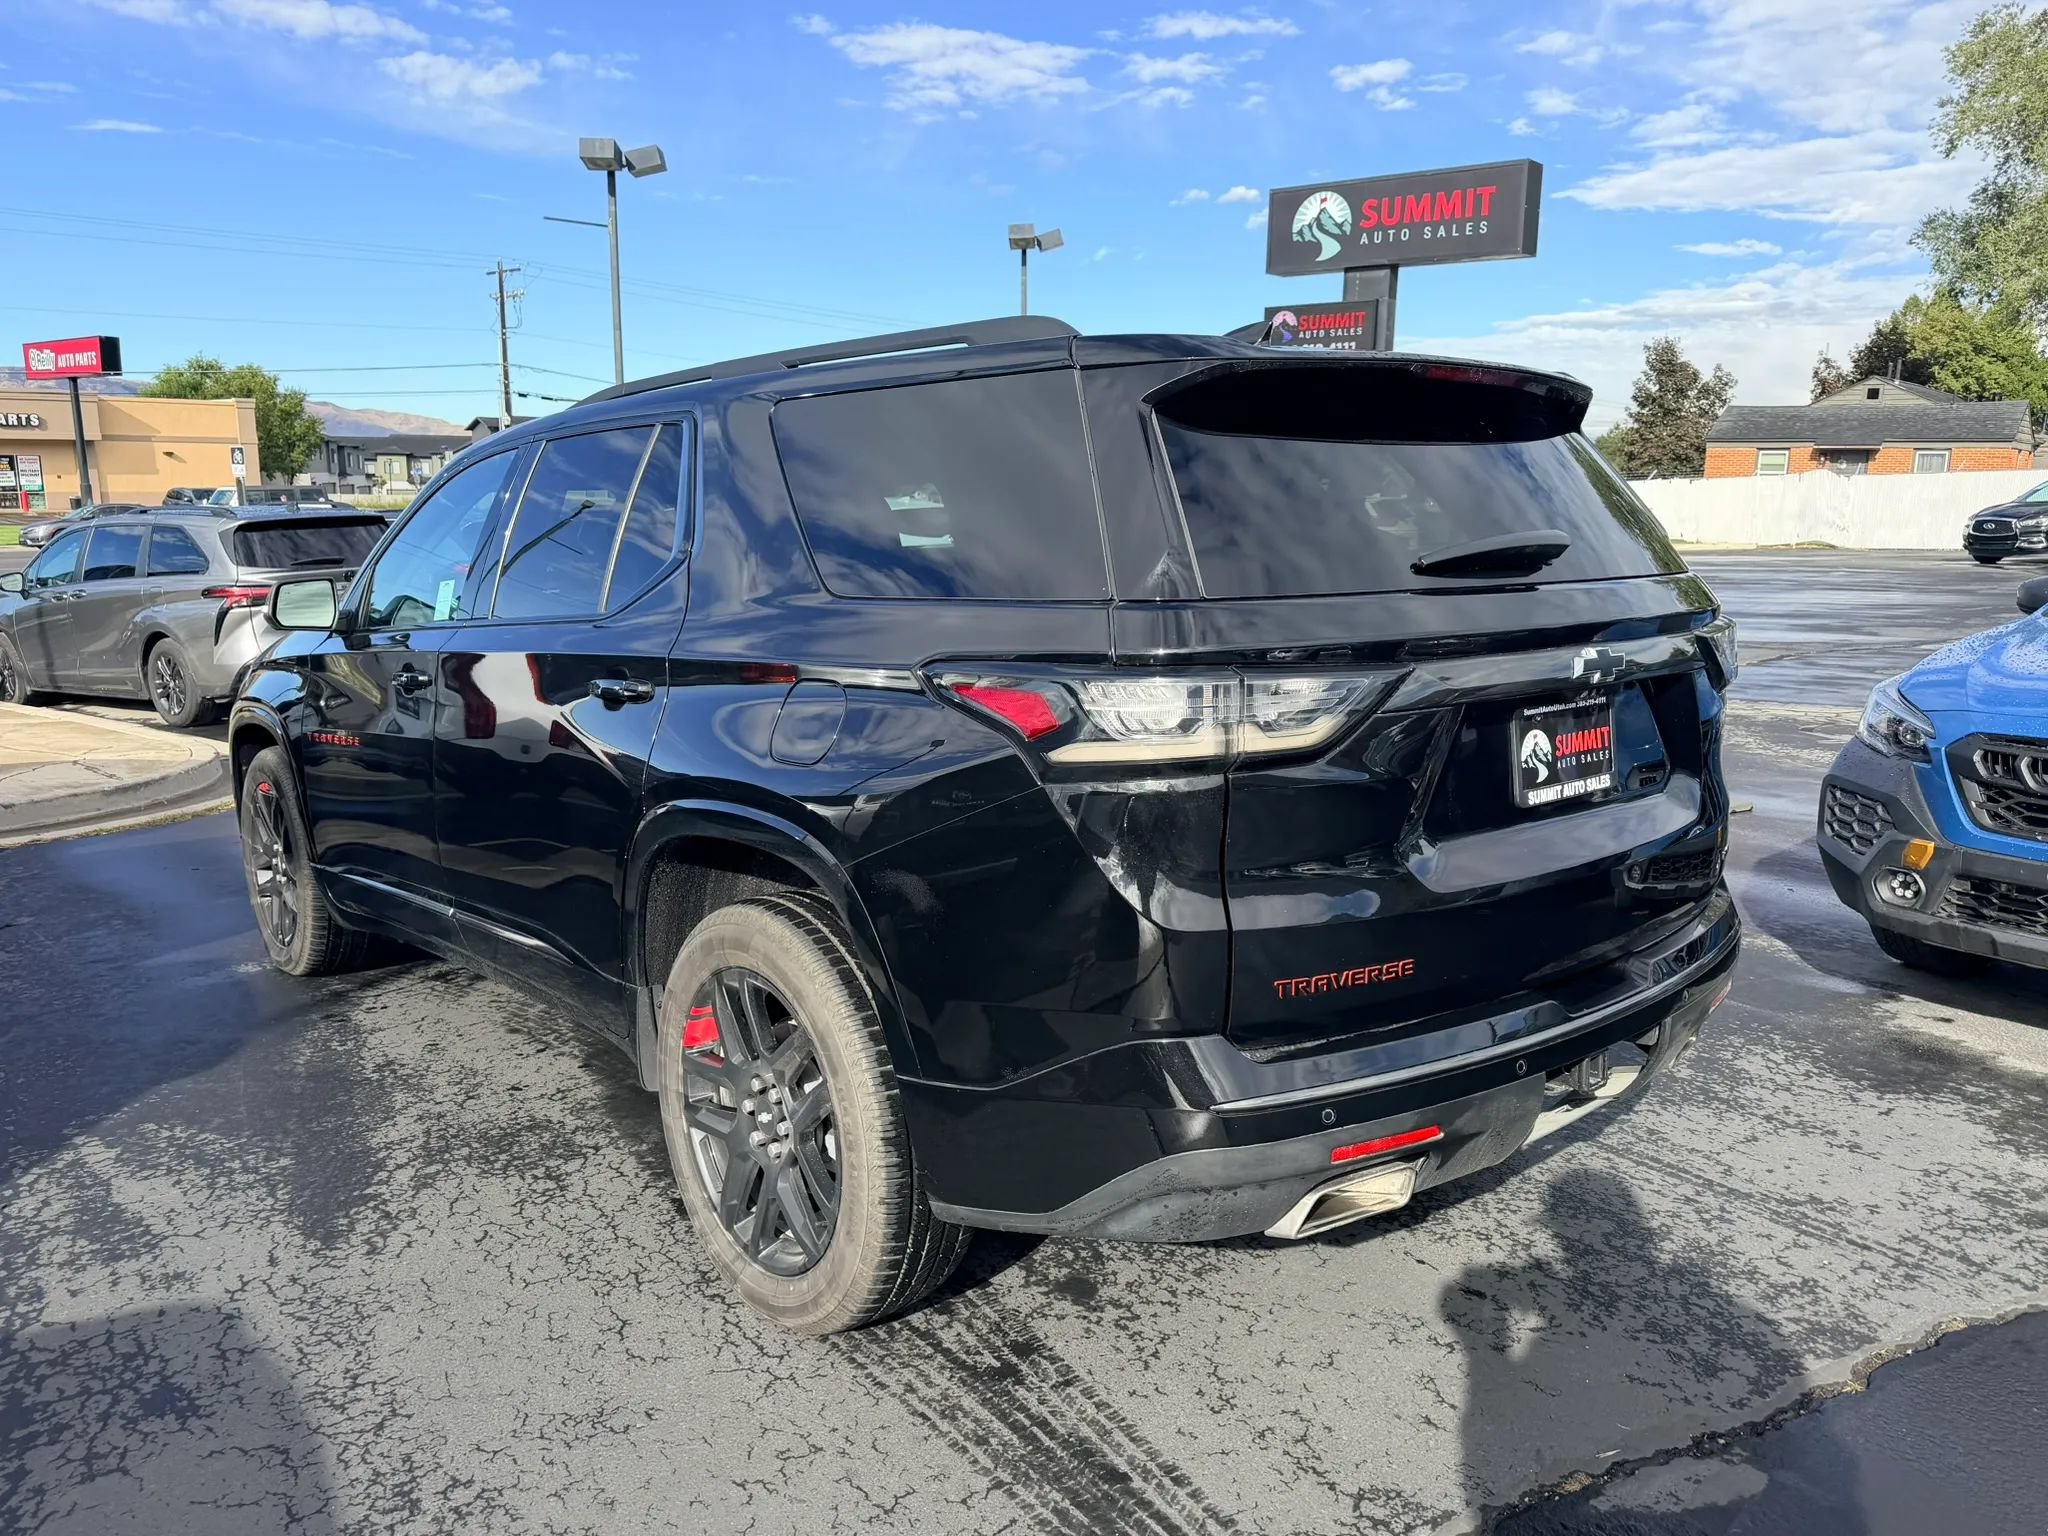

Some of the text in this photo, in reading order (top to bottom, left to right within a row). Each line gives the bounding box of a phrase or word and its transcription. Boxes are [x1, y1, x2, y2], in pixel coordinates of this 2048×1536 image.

[1360, 186, 1496, 229] SUMMIT
[1360, 221, 1488, 245] AUTO SALES
[1299, 312, 1366, 331] SUMMIT
[1299, 327, 1363, 339] AUTO SALES
[58, 353, 76, 368] AUTO
[76, 351, 97, 366] PARTS
[1555, 726, 1610, 757] SUMMIT
[1557, 750, 1609, 769] AUTO SALES
[1528, 774, 1611, 805] SUMMIT AUTO SALES
[1274, 958, 1415, 1000] TRAVERSE
